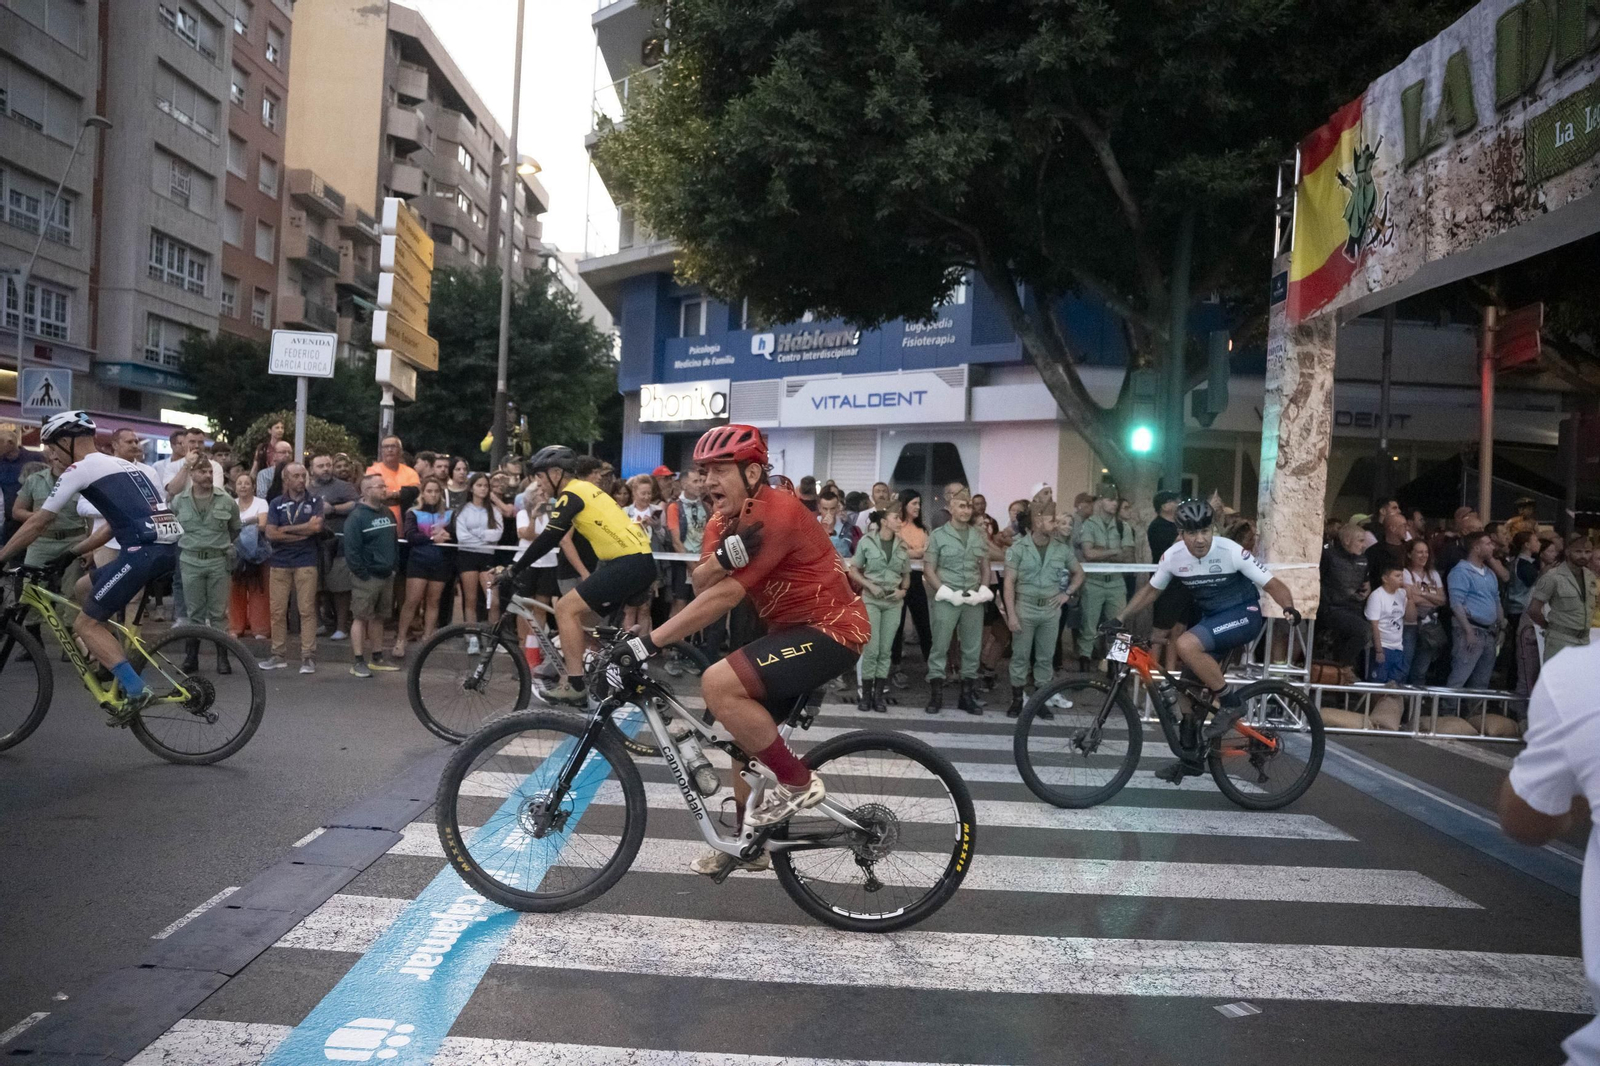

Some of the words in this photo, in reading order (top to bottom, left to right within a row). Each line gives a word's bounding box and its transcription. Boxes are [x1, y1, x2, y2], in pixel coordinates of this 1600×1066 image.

[1555, 120, 1575, 148] La
[291, 337, 331, 347] AVENIDA
[902, 334, 956, 348] Fisioterapia
[284, 347, 320, 360] FEDERICO
[674, 359, 702, 369] Medicina
[702, 358, 711, 367] de
[711, 355, 735, 366] Familia
[777, 353, 801, 363] Centro
[802, 348, 859, 361] Interdisciplinar
[303, 361, 328, 373] LORCA
[640, 386, 727, 418] Phonika
[811, 391, 928, 410] VITALDENT
[602, 525, 628, 548] Santander
[94, 562, 132, 601] KOMOMOLOS
[1212, 616, 1249, 635] KOMOMOLOS
[47, 614, 88, 676] ORBEA
[756, 653, 780, 667] LA
[662, 745, 704, 822] cannondale
[444, 826, 471, 872] MAXXIS
[956, 822, 970, 872] MAXXIS
[398, 894, 489, 982] cajamar
